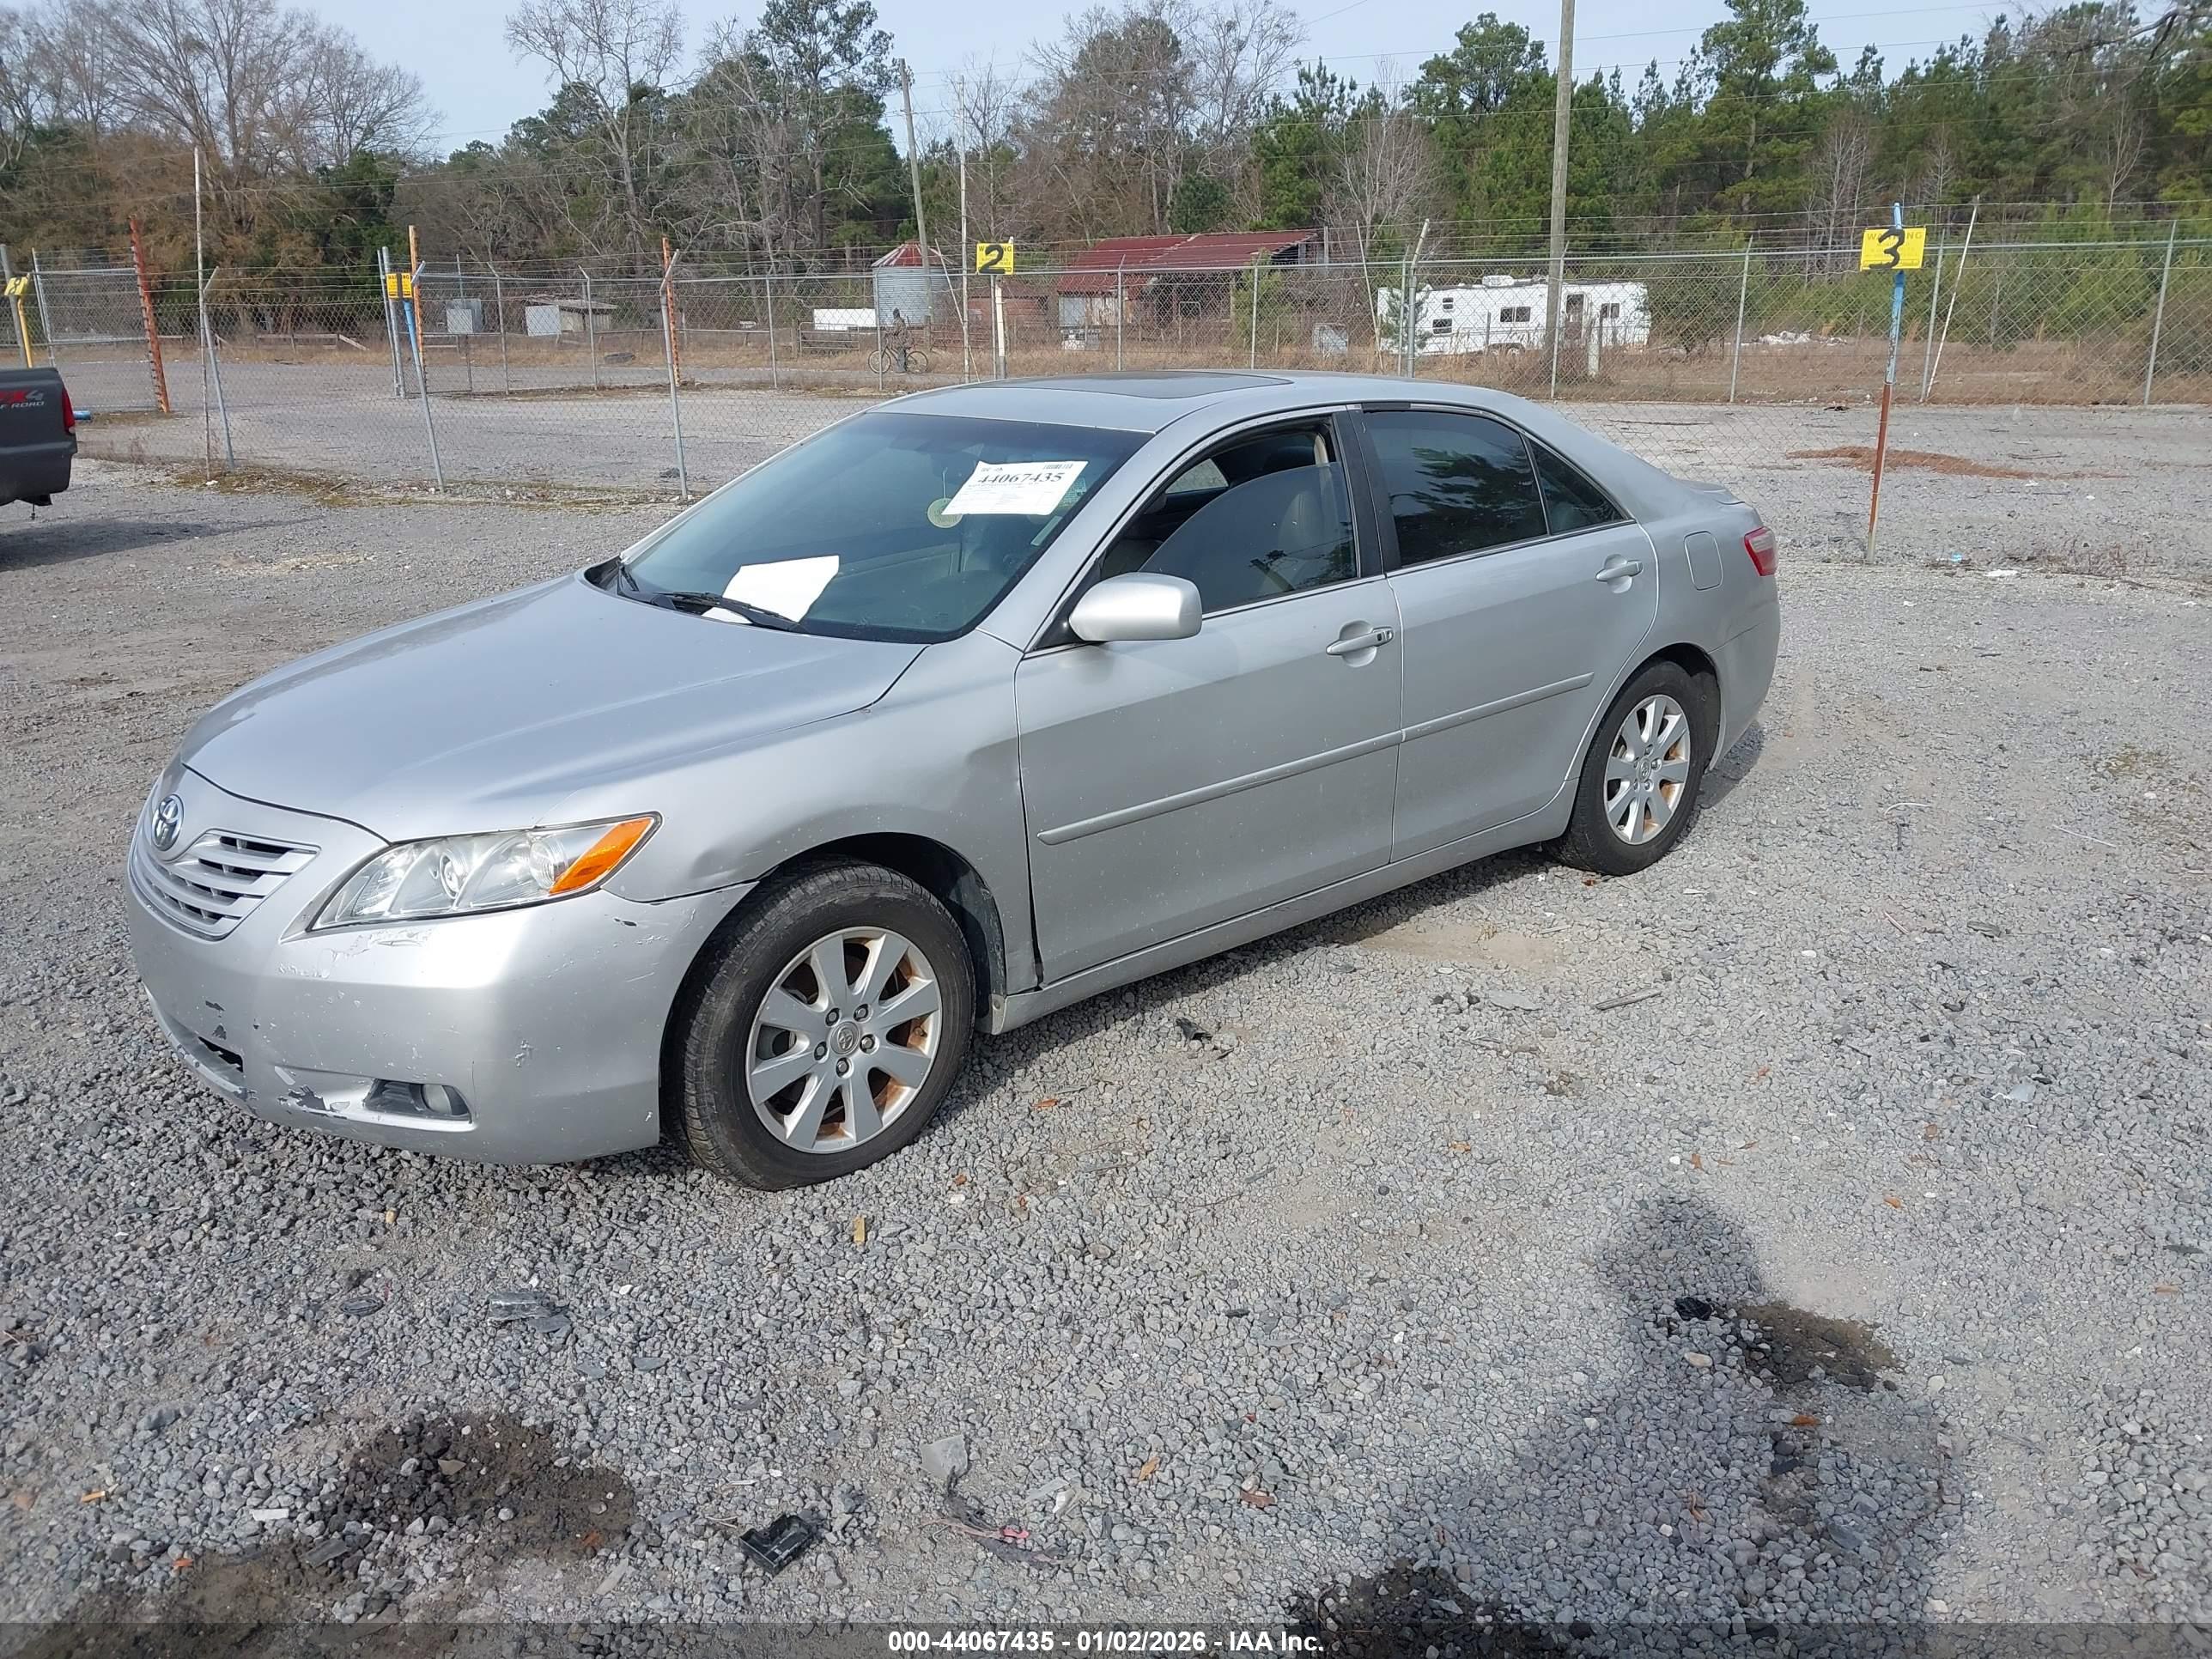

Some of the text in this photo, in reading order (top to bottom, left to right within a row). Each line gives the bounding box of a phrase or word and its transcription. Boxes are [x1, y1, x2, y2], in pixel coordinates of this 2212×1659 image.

[978, 244, 1006, 274] 2
[1869, 225, 1905, 269] 3
[977, 471, 1065, 483] 44067435
